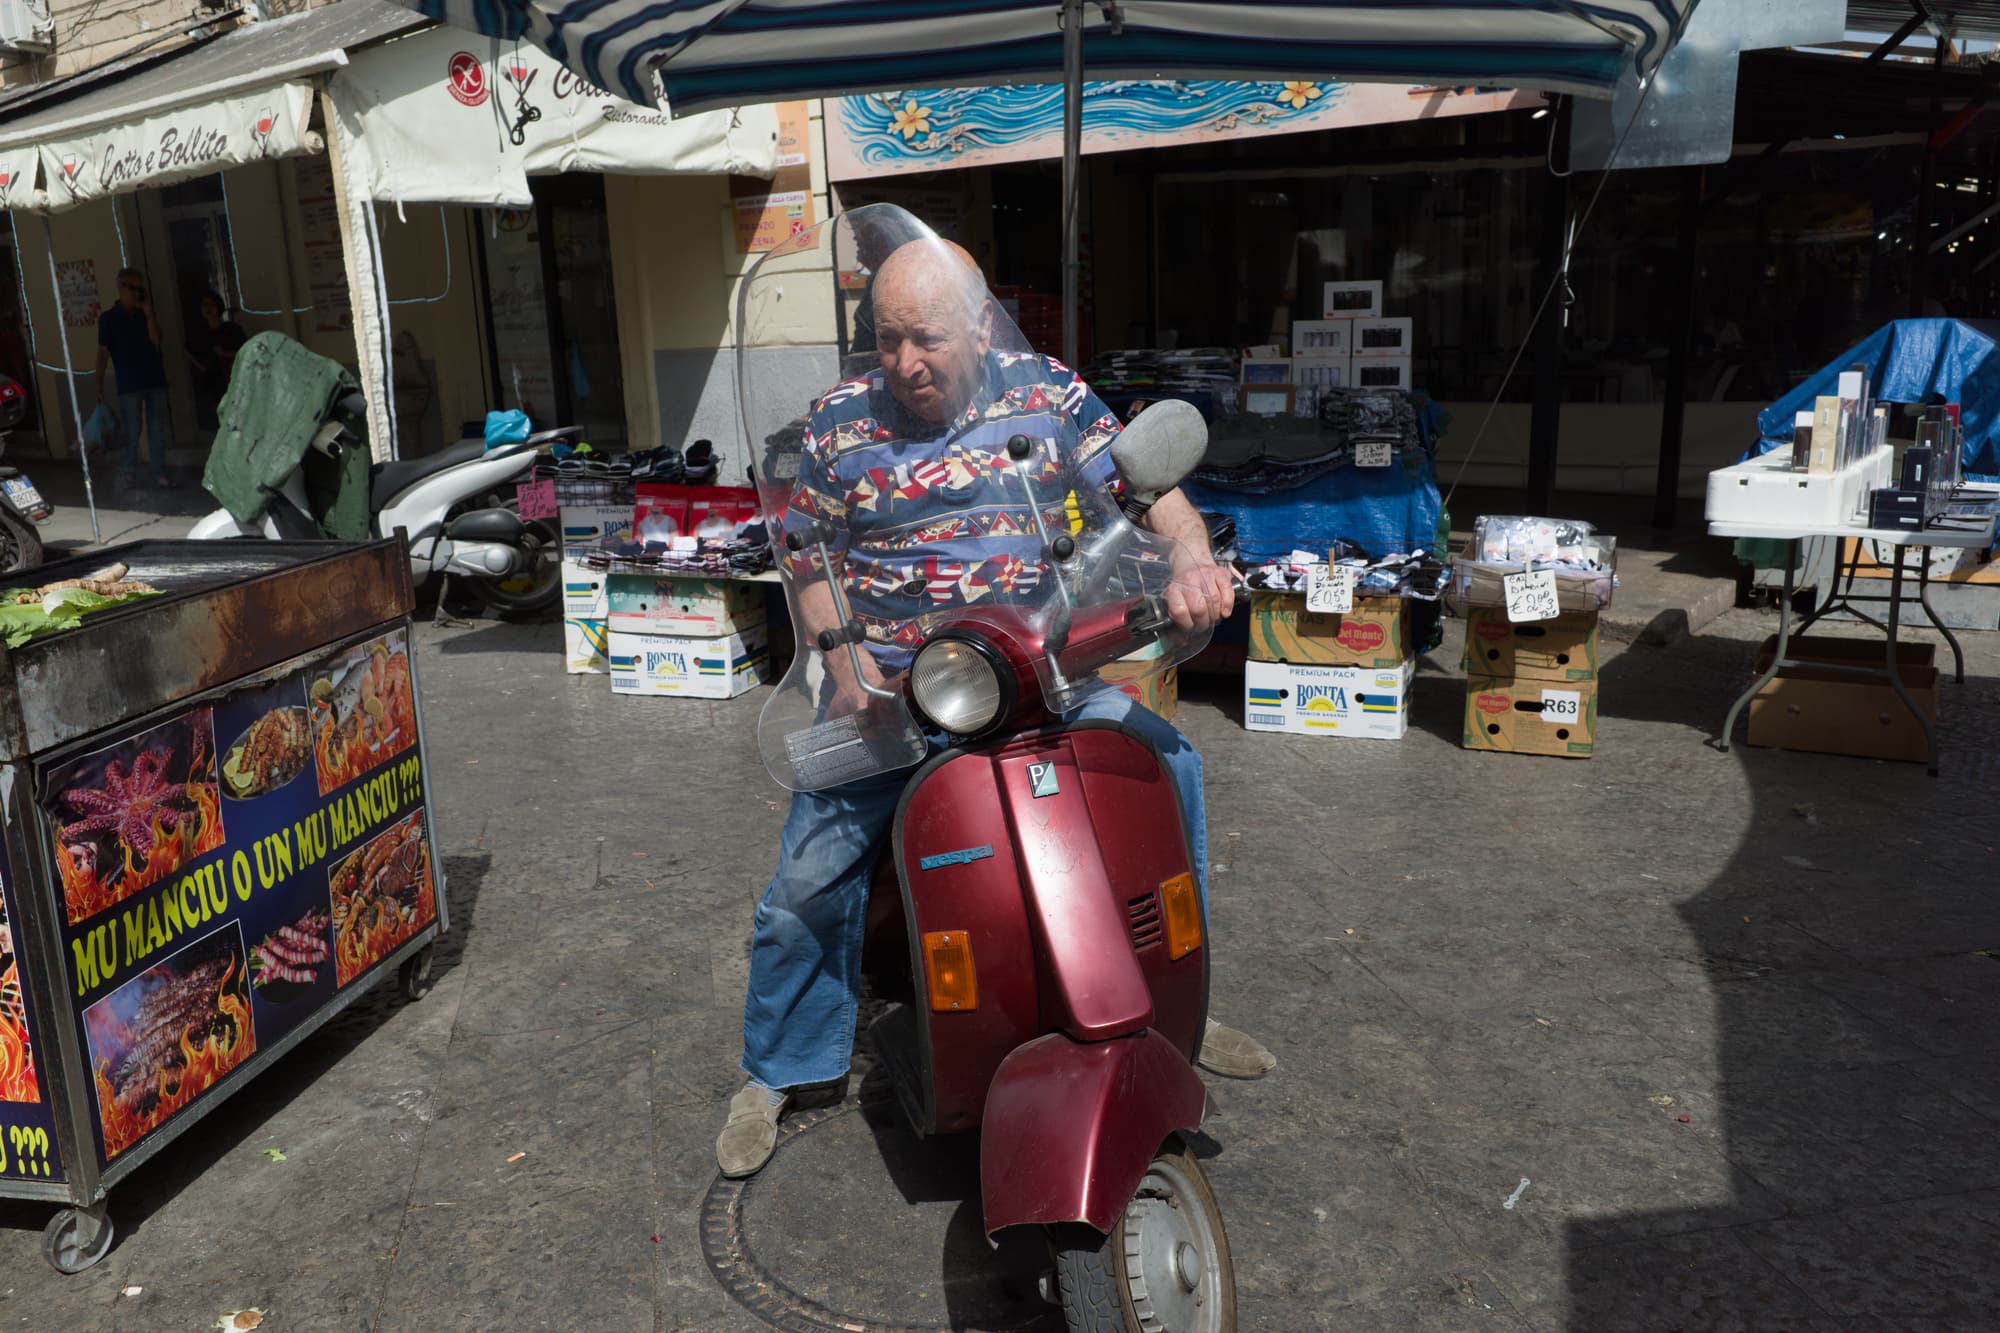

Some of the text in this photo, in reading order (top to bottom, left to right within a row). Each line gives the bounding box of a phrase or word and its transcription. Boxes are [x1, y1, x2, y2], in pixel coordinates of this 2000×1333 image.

[602, 105, 668, 125] Ristorante
[100, 143, 142, 190] Cotto
[146, 150, 155, 173] e
[159, 127, 227, 169] Bollito
[1315, 565, 1349, 575] CAZE
[1509, 573, 1539, 584] CALE
[1339, 628, 1383, 642] Del Monte
[646, 651, 688, 674] BONITA
[1289, 668, 1331, 678] PREMIUM
[1296, 684, 1348, 710] BONITA
[1544, 698, 1577, 714] R63
[71, 755, 422, 997] MU MANCIU O UN MU MANCIU ???
